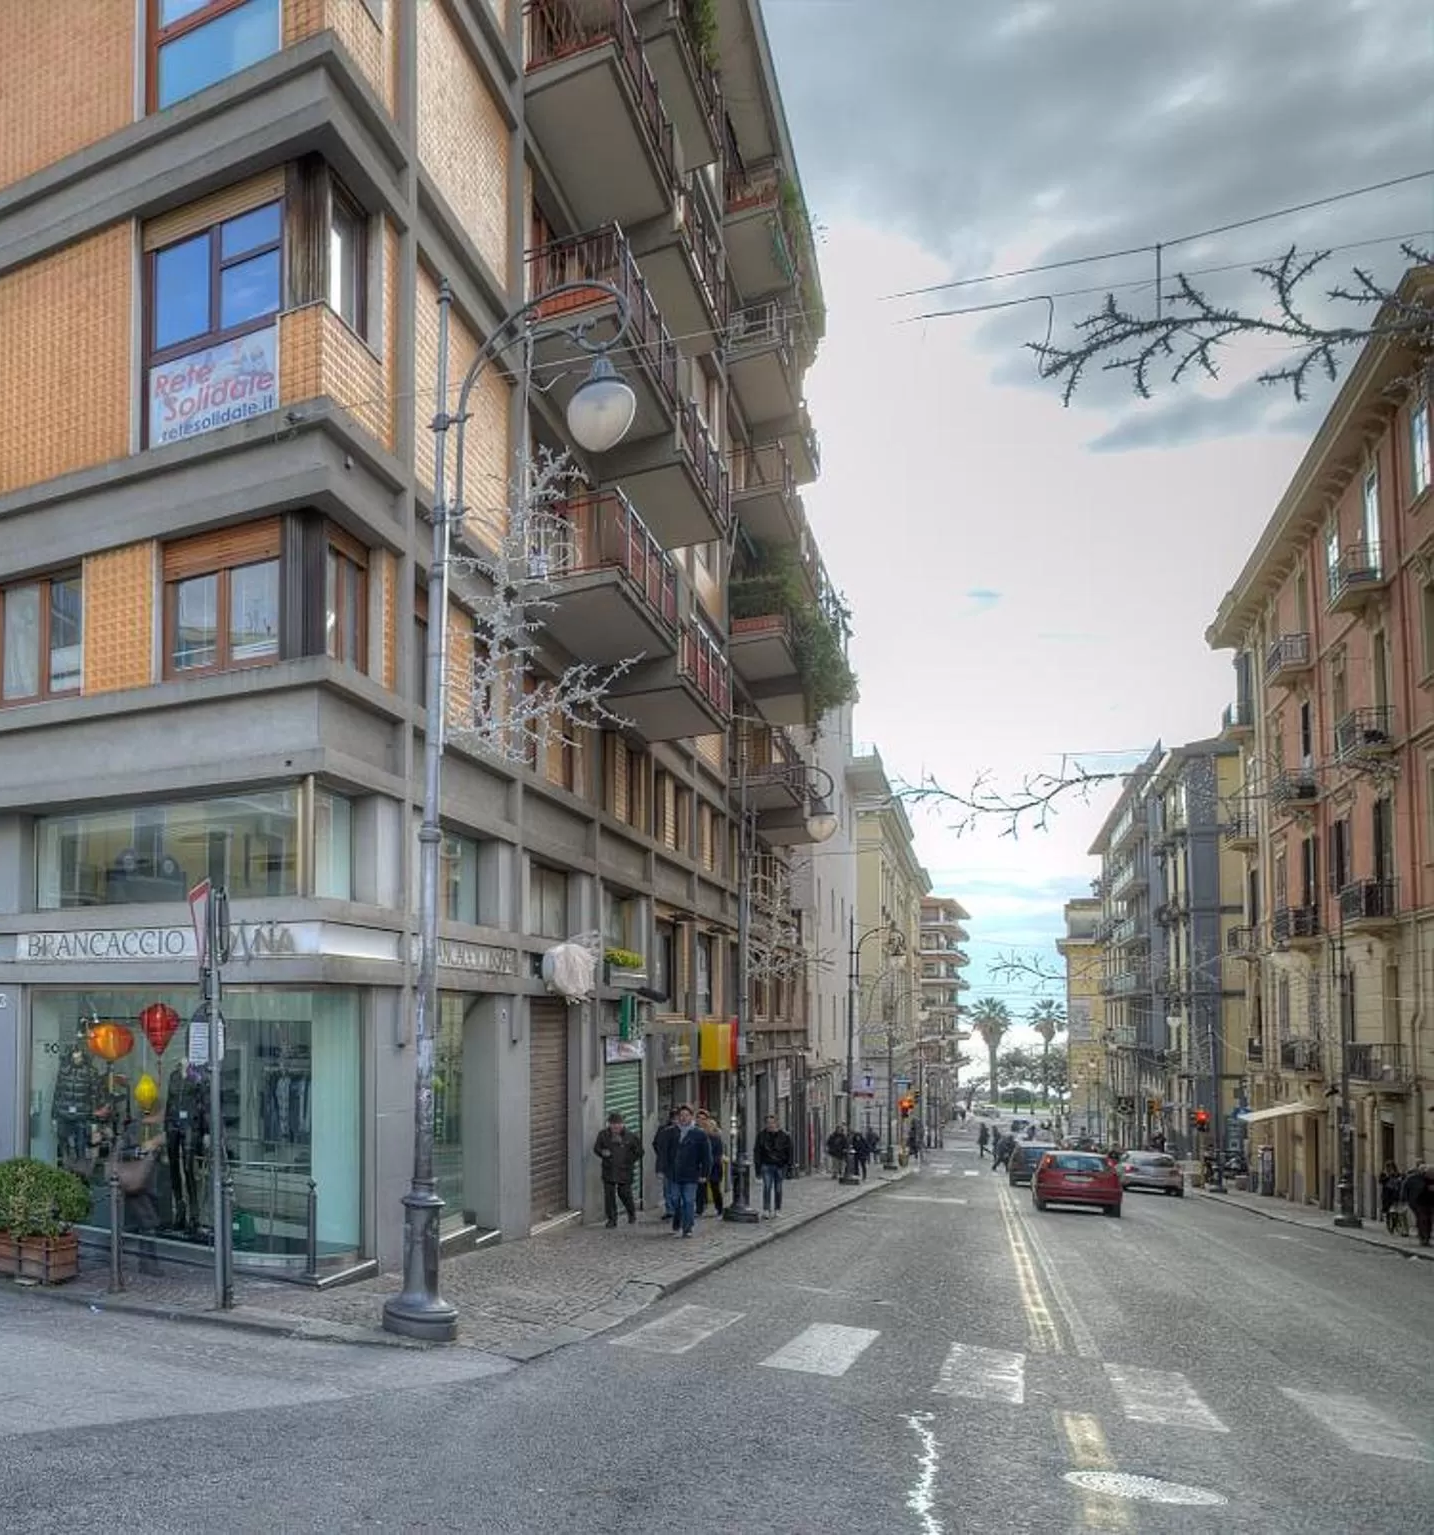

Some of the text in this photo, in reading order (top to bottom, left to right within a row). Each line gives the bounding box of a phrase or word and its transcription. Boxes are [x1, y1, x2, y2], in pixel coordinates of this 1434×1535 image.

[155, 362, 213, 398] Rete
[163, 371, 275, 421] Solidale
[28, 929, 185, 957] BRANCACCIO
